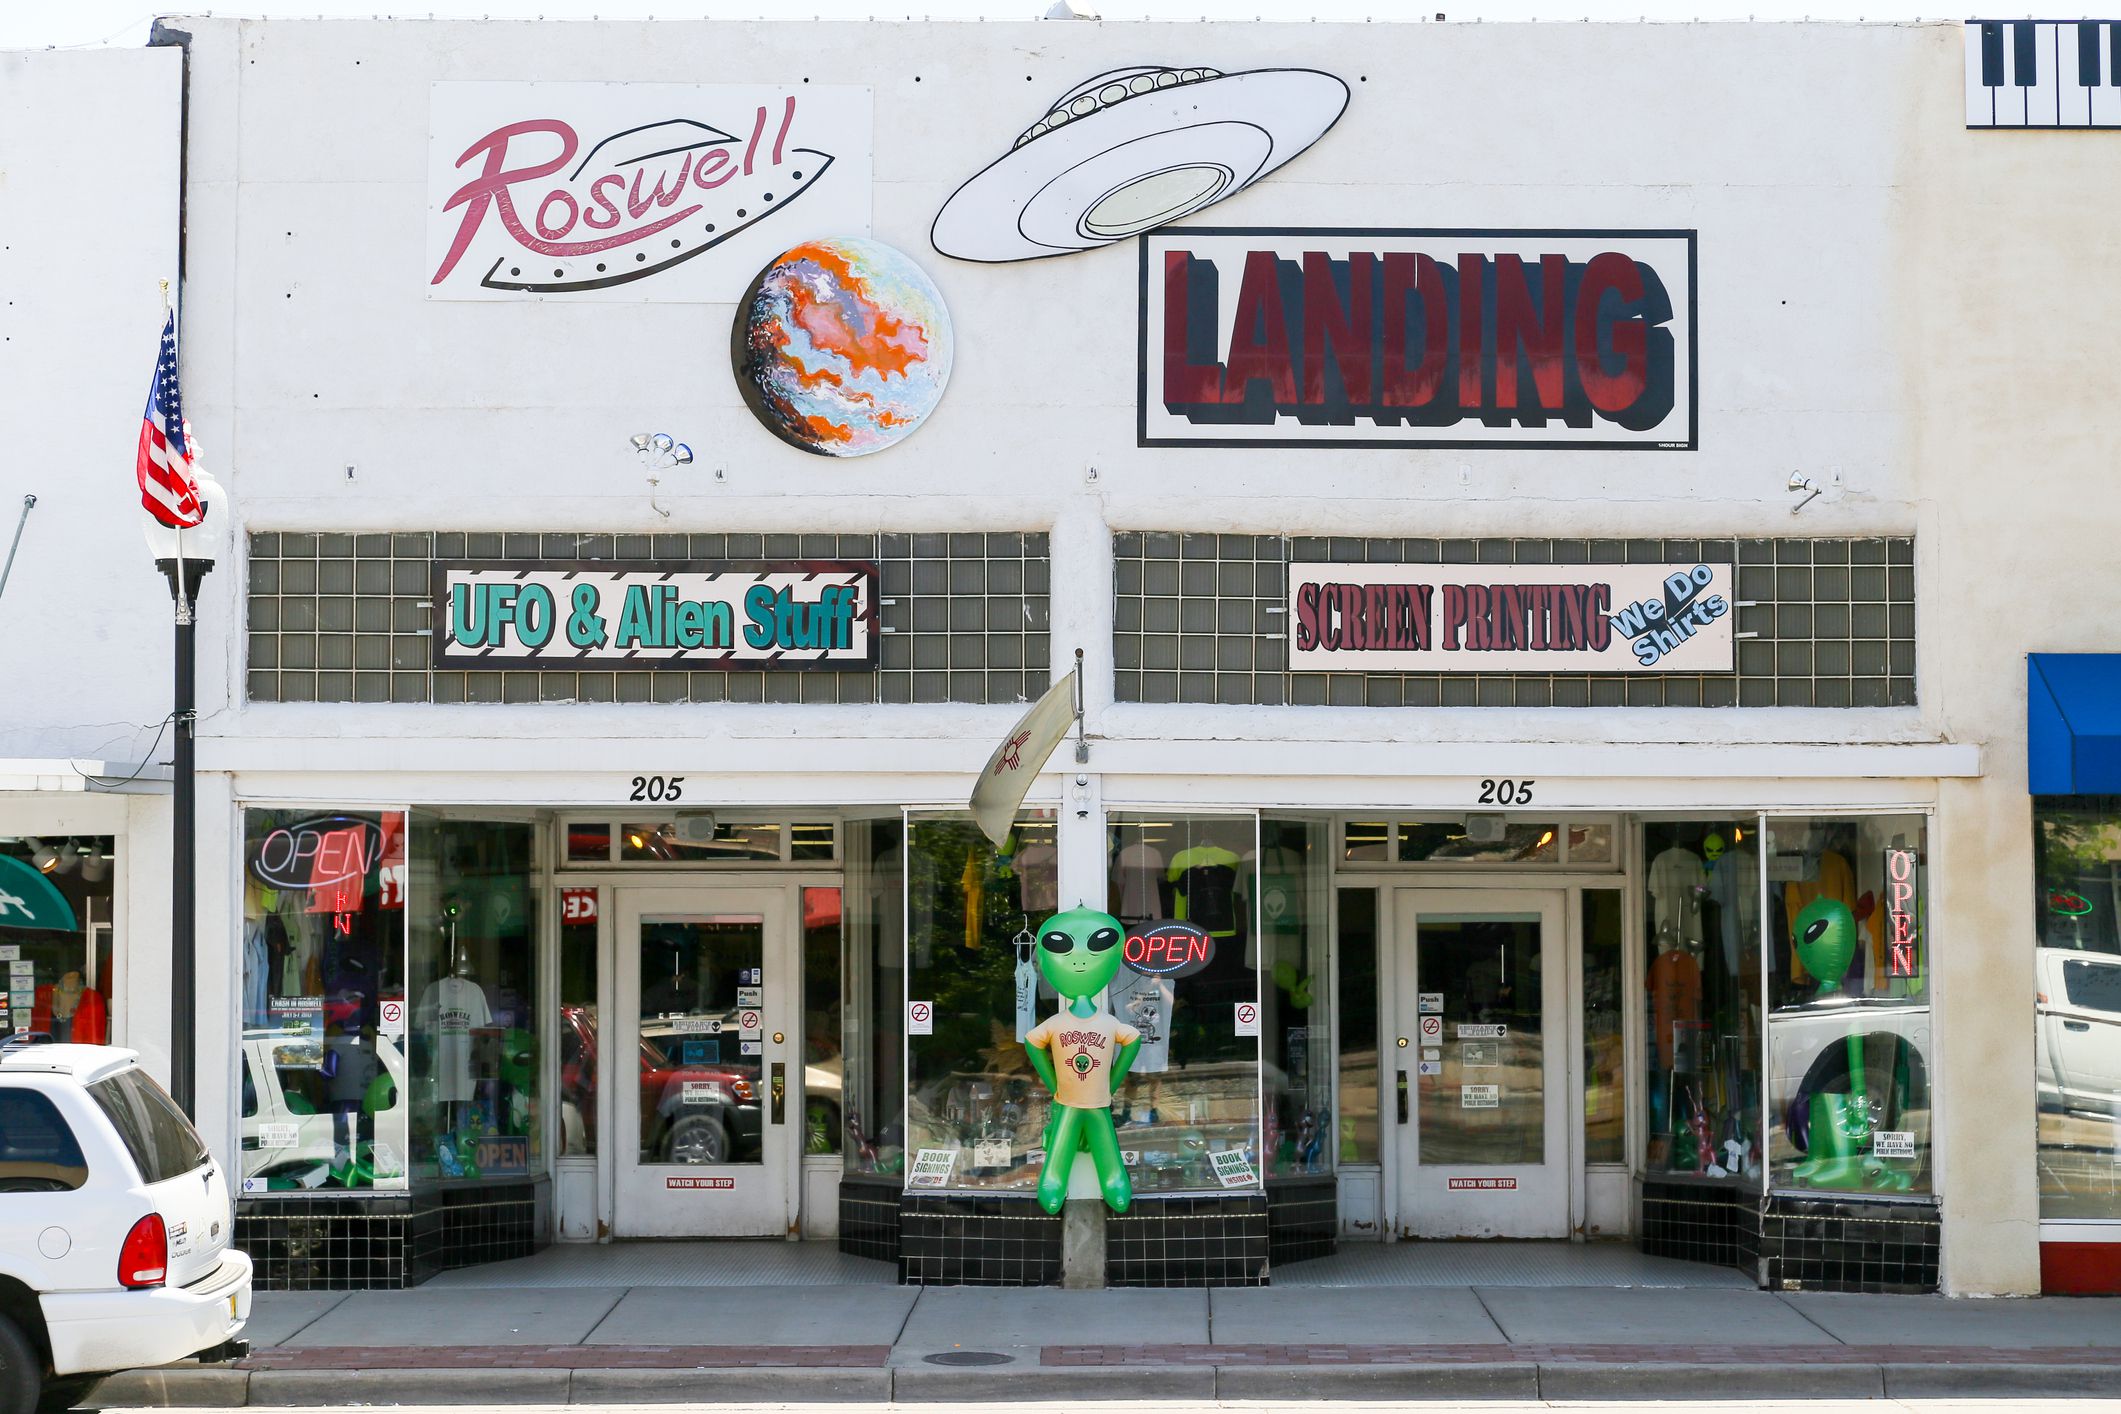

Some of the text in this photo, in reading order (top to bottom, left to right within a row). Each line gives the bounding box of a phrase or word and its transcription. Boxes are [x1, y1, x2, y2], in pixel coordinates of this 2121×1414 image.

[430, 96, 796, 285] Roswell
[1163, 250, 1674, 431] LANDING
[1609, 563, 1714, 640] We Do
[452, 583, 859, 650] UFO & Alien Stuff
[1296, 582, 1612, 652] SCREEN PRINTING
[1631, 591, 1729, 667] Shirts
[629, 775, 685, 802] 205
[1478, 779, 1535, 805] 205
[261, 829, 377, 875] OPEN
[1889, 850, 1913, 977] OPEN
[1124, 935, 1209, 962] OPEN
[1060, 1030, 1106, 1050] ROSWELL
[476, 1143, 526, 1168] OPEN
[914, 1162, 951, 1174] SIGNINGS
[922, 1152, 951, 1163] BOOK
[1216, 1152, 1243, 1166] BOOK
[1216, 1162, 1250, 1177] SIGNINGS
[1226, 1174, 1248, 1185] INSIDE
[668, 1179, 733, 1187] WATCH YOUR STEP
[1450, 1180, 1515, 1188] WATCH YOUR STEP
